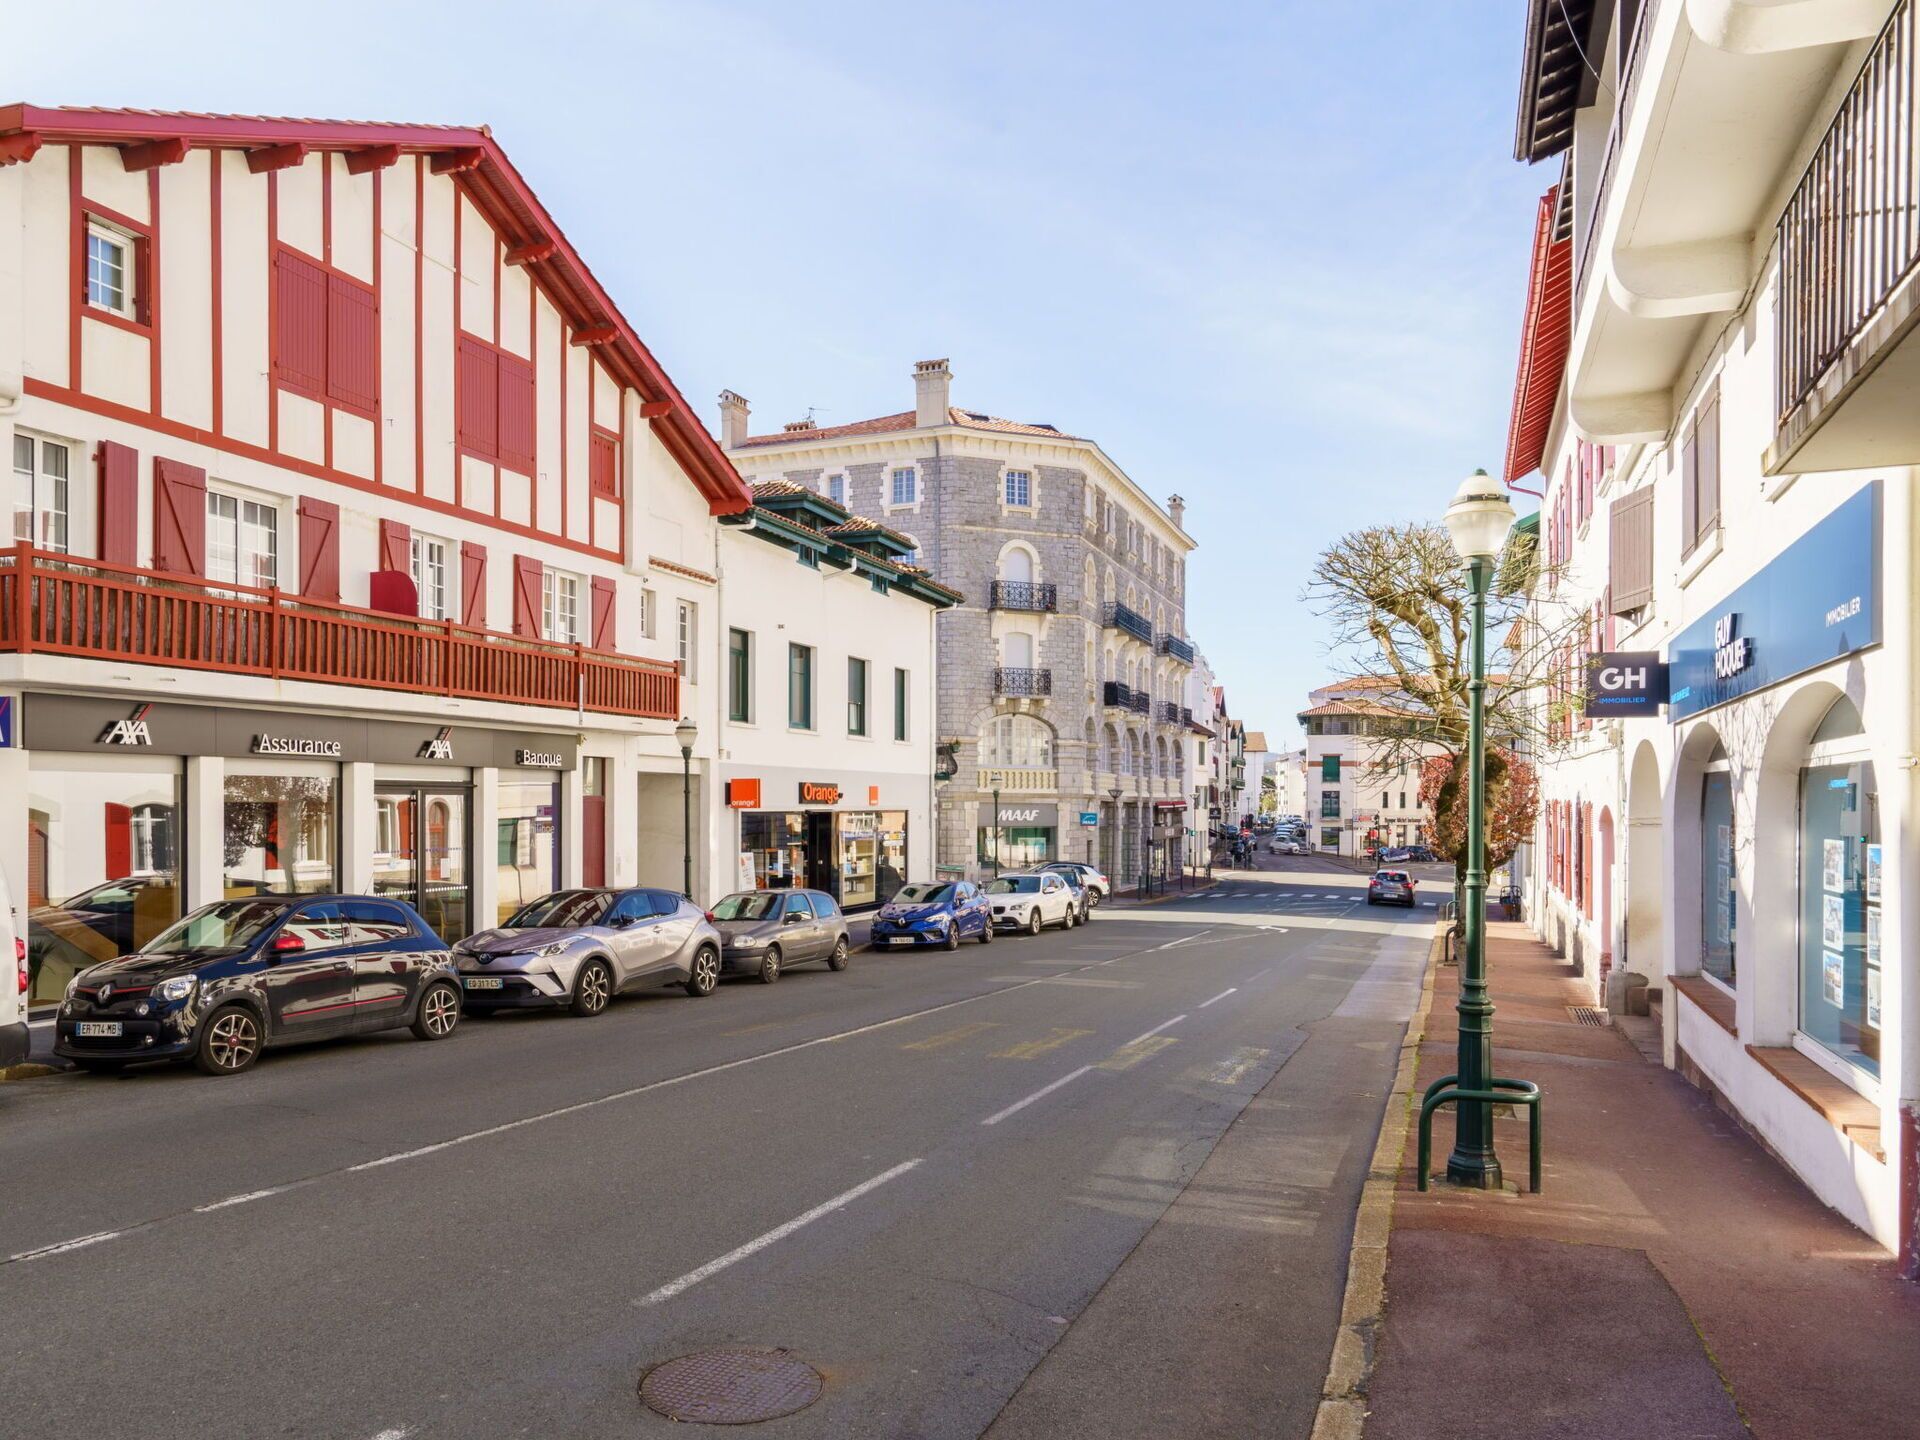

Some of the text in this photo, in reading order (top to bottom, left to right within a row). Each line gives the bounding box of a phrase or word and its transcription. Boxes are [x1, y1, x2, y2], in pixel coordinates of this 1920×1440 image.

[1825, 596, 1861, 629] IMMOBILIER
[1715, 612, 1732, 650] GUY
[1599, 667, 1646, 690] GH
[1599, 696, 1646, 704] IMMOBILIER
[105, 719, 153, 746] AXA
[260, 733, 341, 755] Assurance
[425, 740, 454, 760] AXA
[523, 749, 562, 768] Banque
[804, 783, 839, 804] Orange
[998, 809, 1040, 822] MAAF
